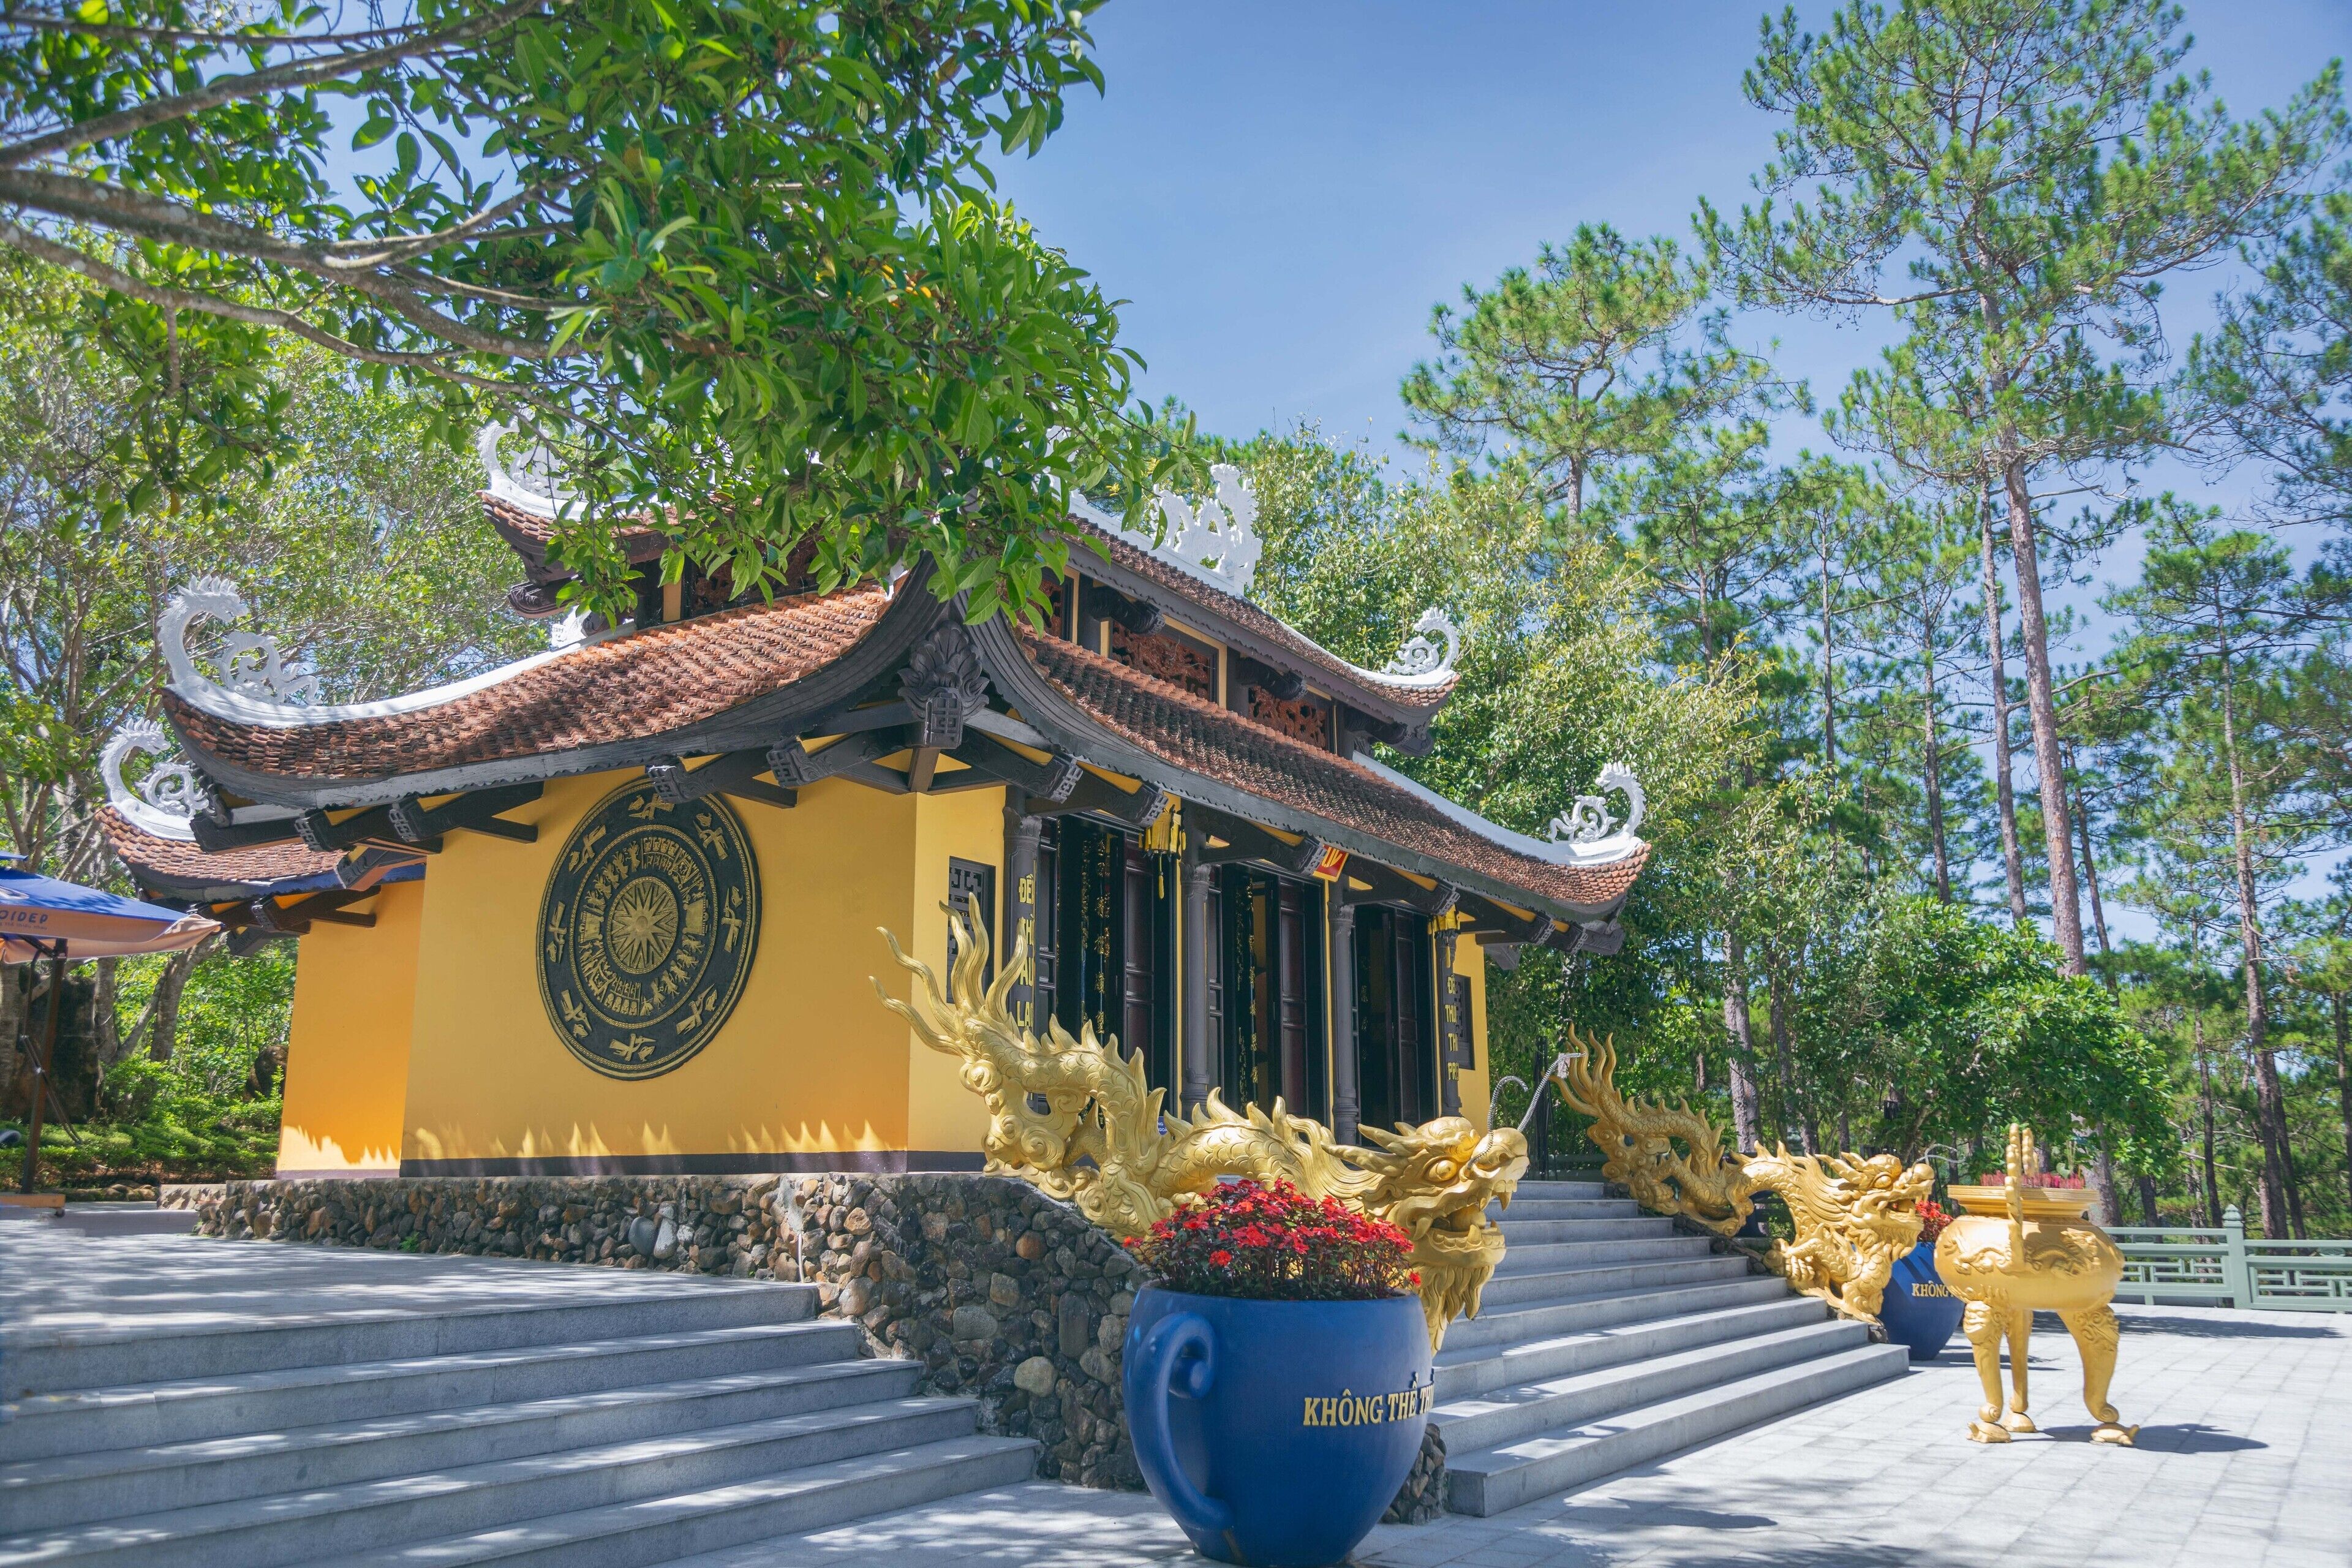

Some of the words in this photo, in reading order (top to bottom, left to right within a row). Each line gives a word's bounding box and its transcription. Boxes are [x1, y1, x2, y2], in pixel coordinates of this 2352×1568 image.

[1911, 1280, 1948, 1297] KHÔNG
[1303, 1388, 1384, 1427] KHÔNG
[1387, 1372, 1419, 1422] THỂ
